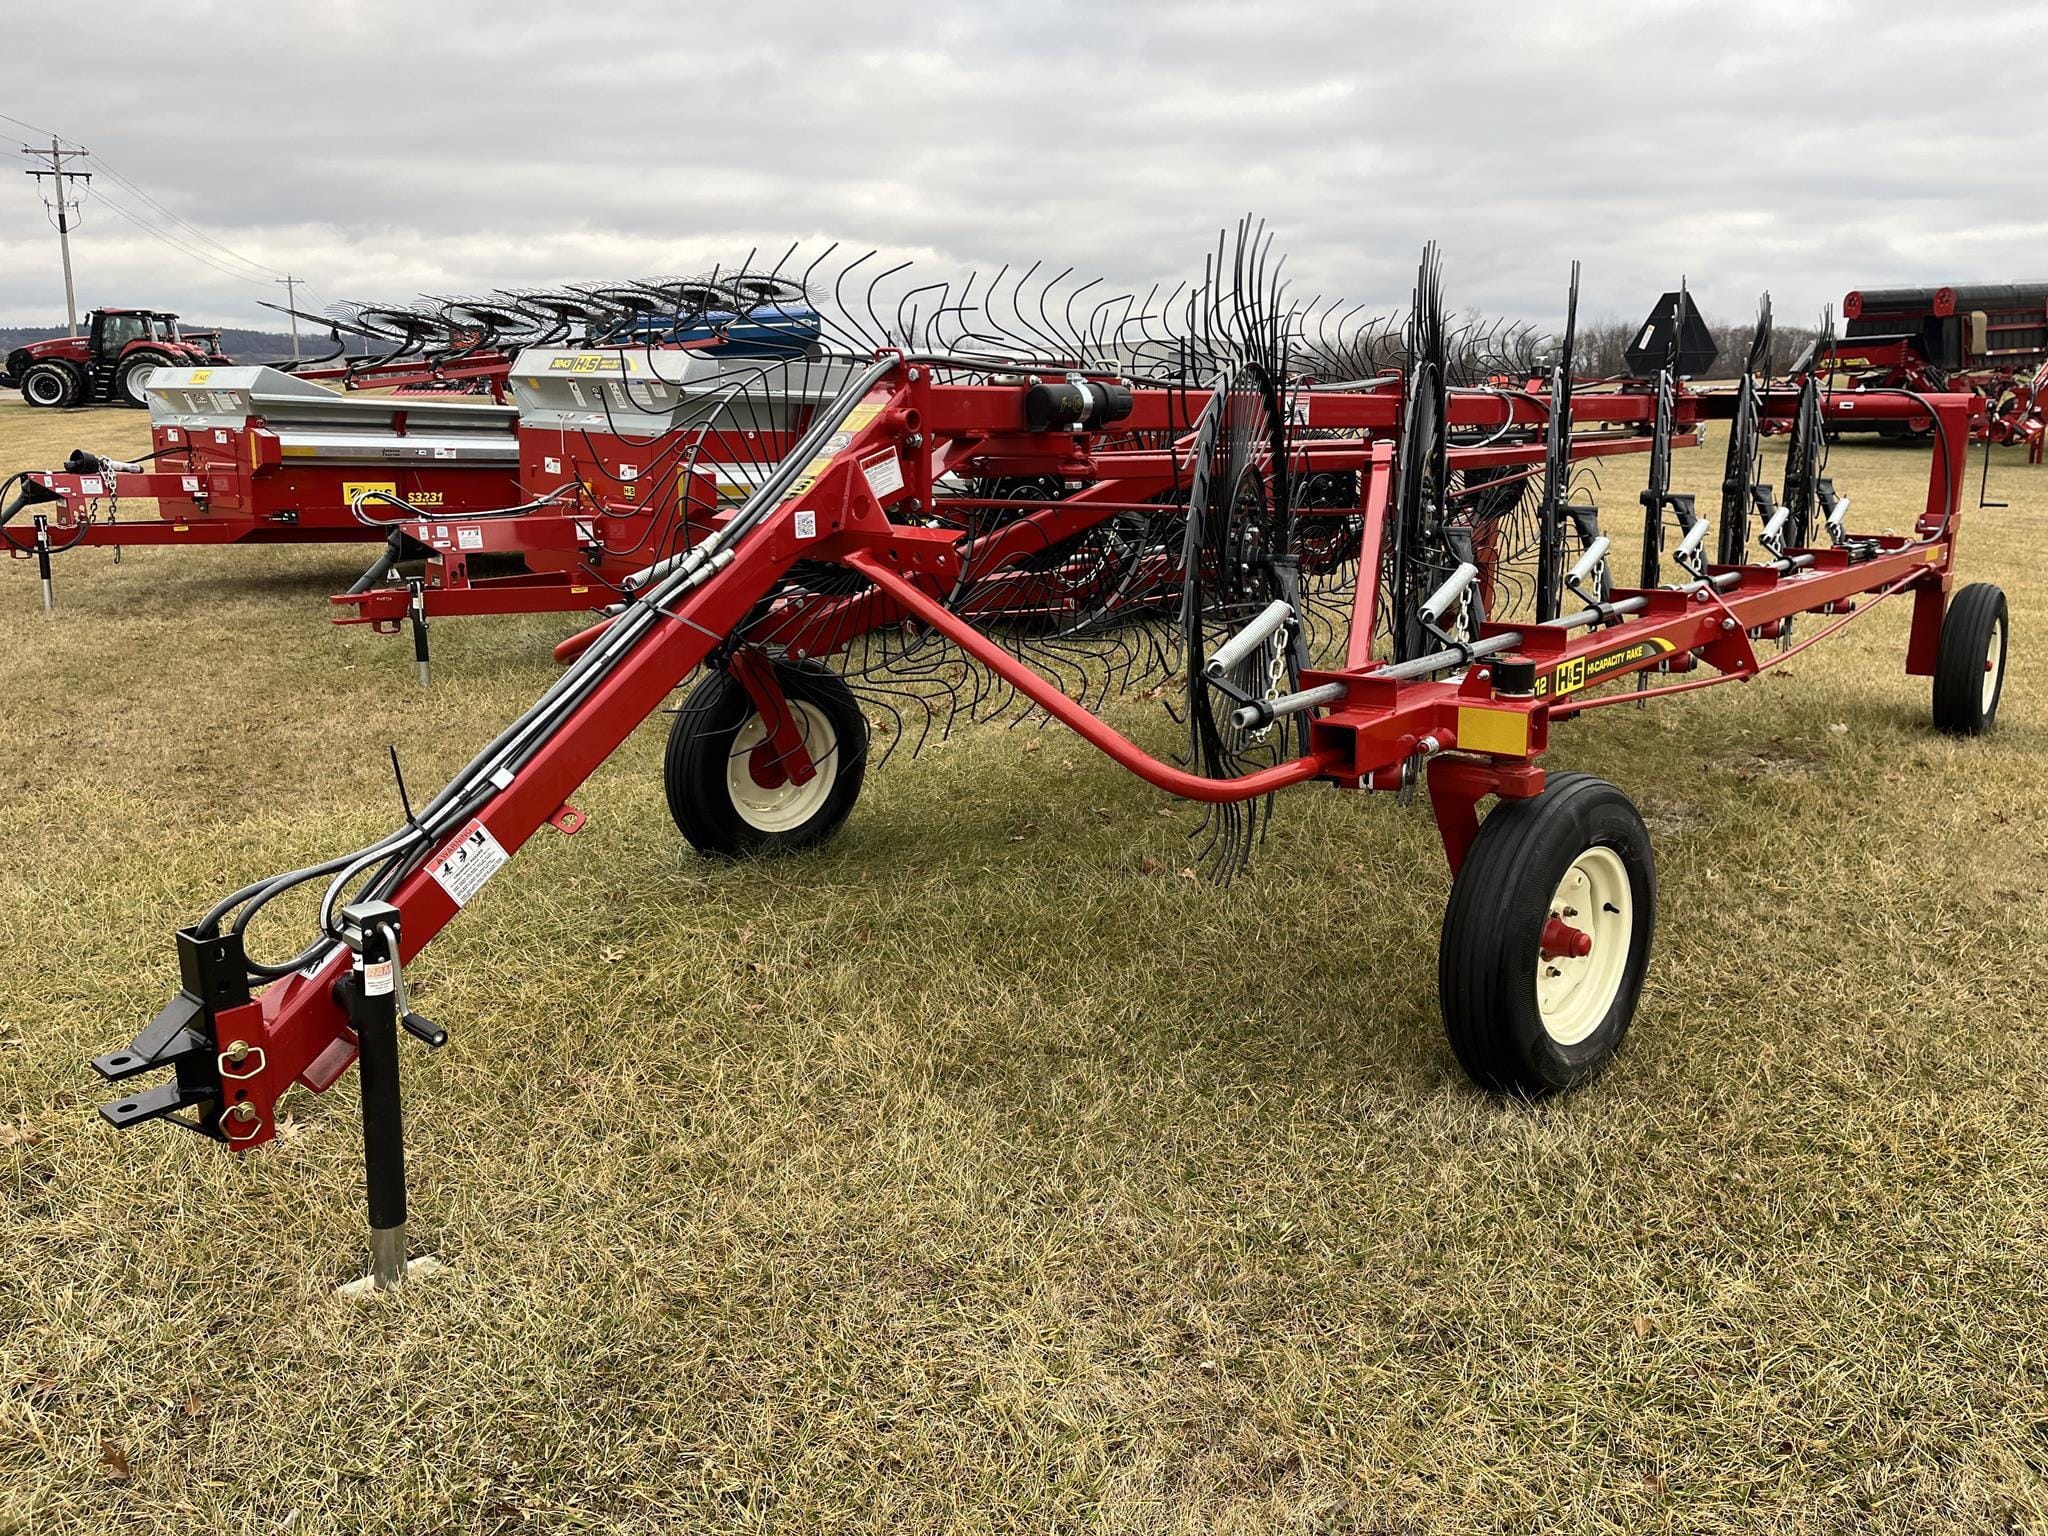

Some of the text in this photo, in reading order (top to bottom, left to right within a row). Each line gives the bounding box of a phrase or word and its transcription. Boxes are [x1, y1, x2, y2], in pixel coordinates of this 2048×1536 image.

[407, 492, 444, 503] S3231
[1557, 662, 1584, 694] H&S
[1586, 653, 1627, 676] HI-CAPACITY
[1626, 646, 1643, 661] RAKE
[442, 828, 474, 860] WARNING
